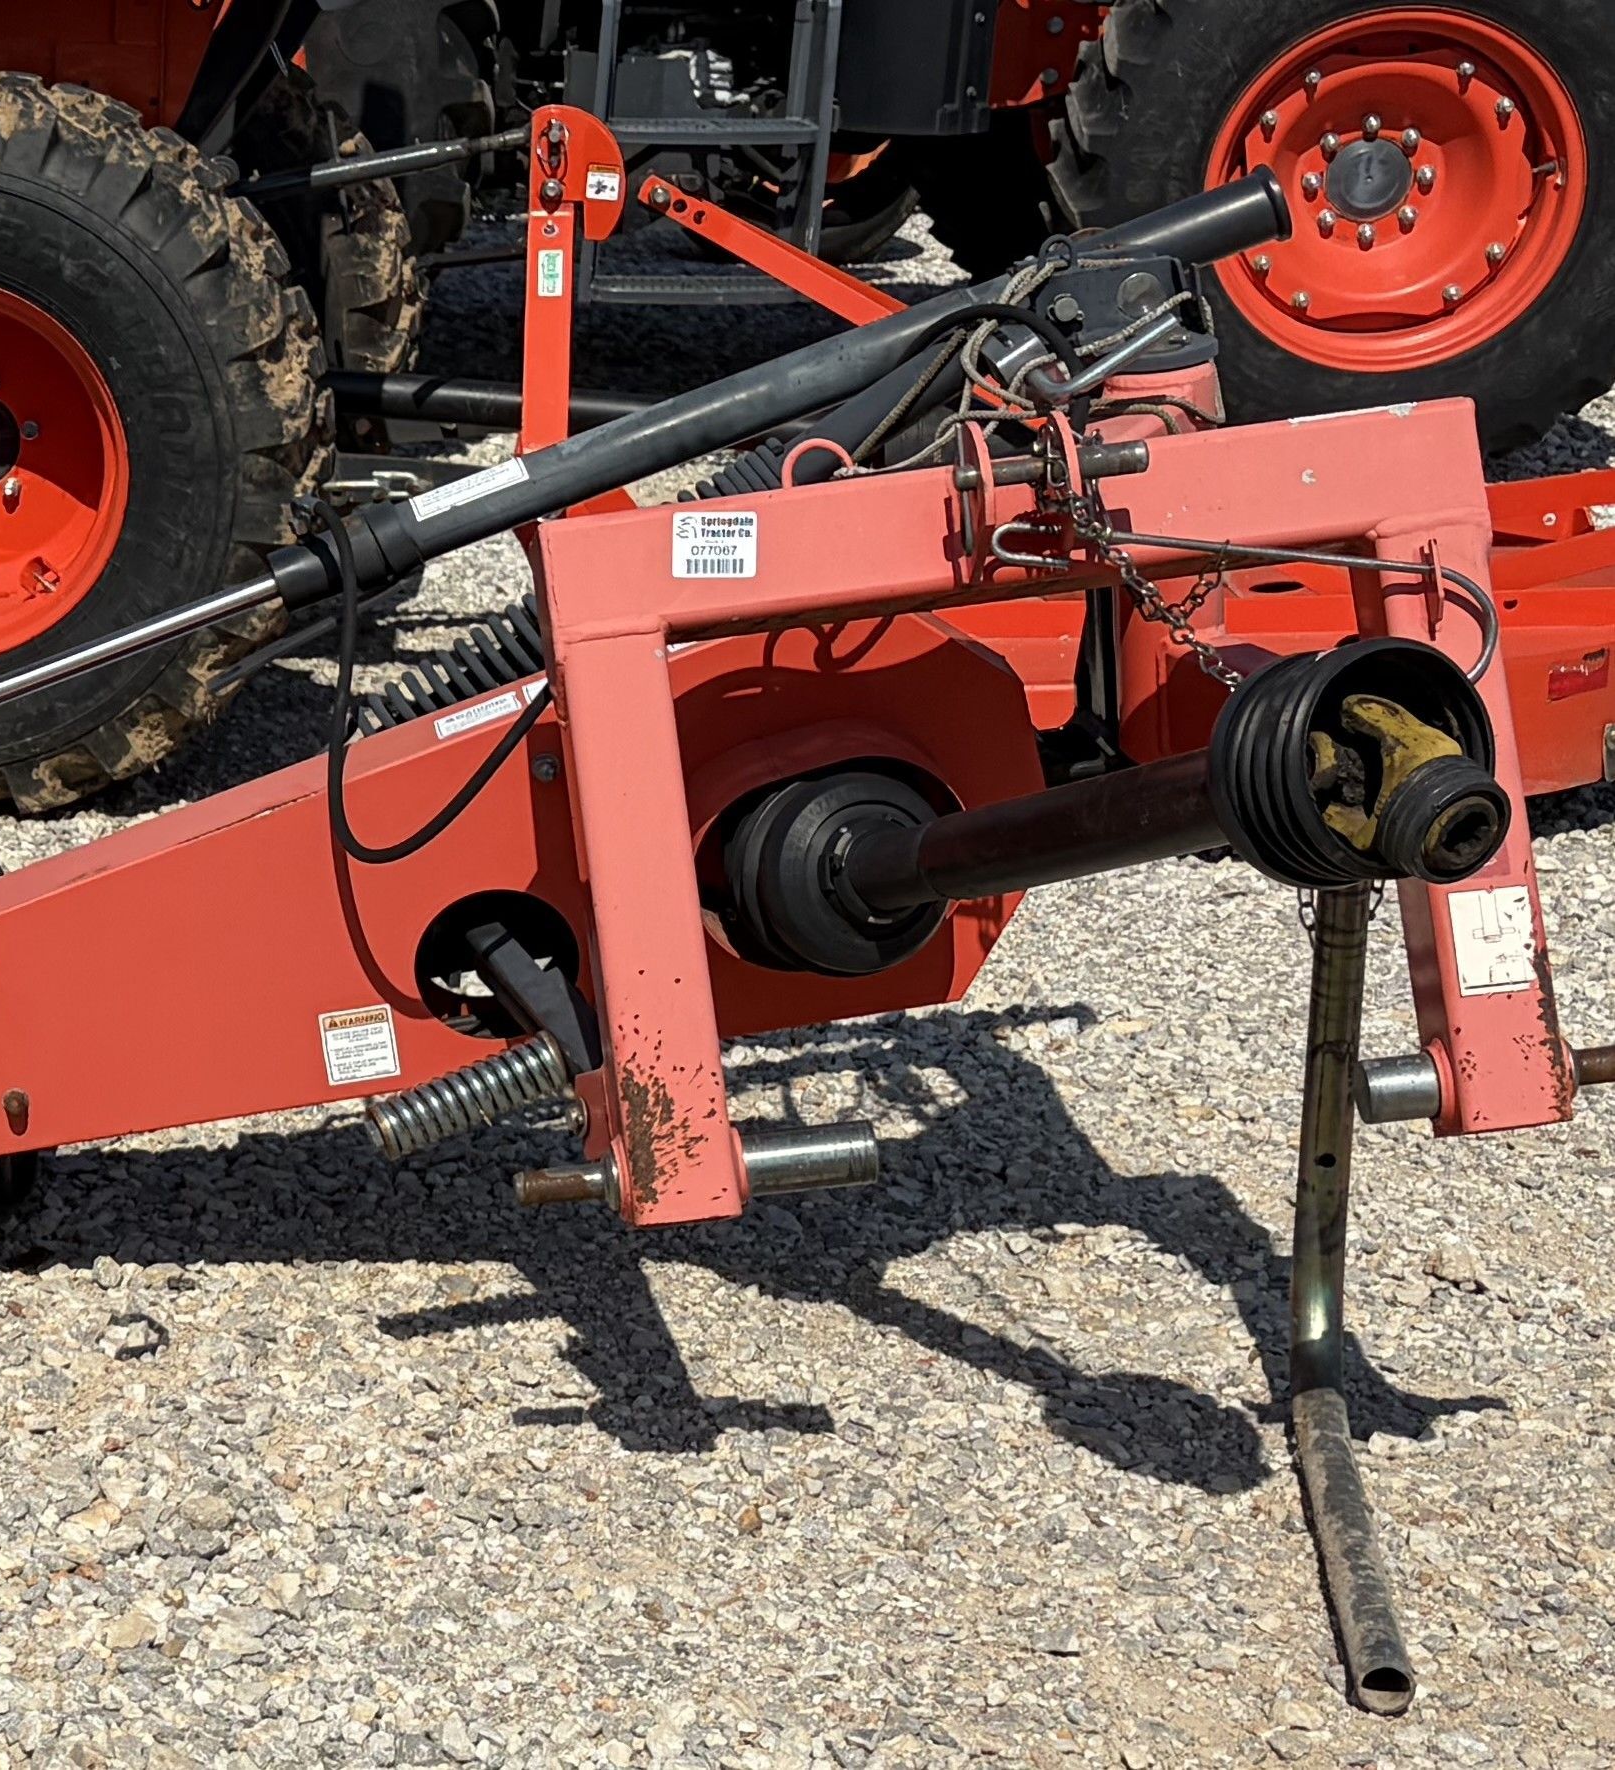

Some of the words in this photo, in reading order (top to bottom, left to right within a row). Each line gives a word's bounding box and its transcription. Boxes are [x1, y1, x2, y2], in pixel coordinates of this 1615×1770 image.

[701, 516, 754, 528] Springdale
[701, 527, 736, 538] Tractor
[339, 1012, 386, 1027] WARNING
